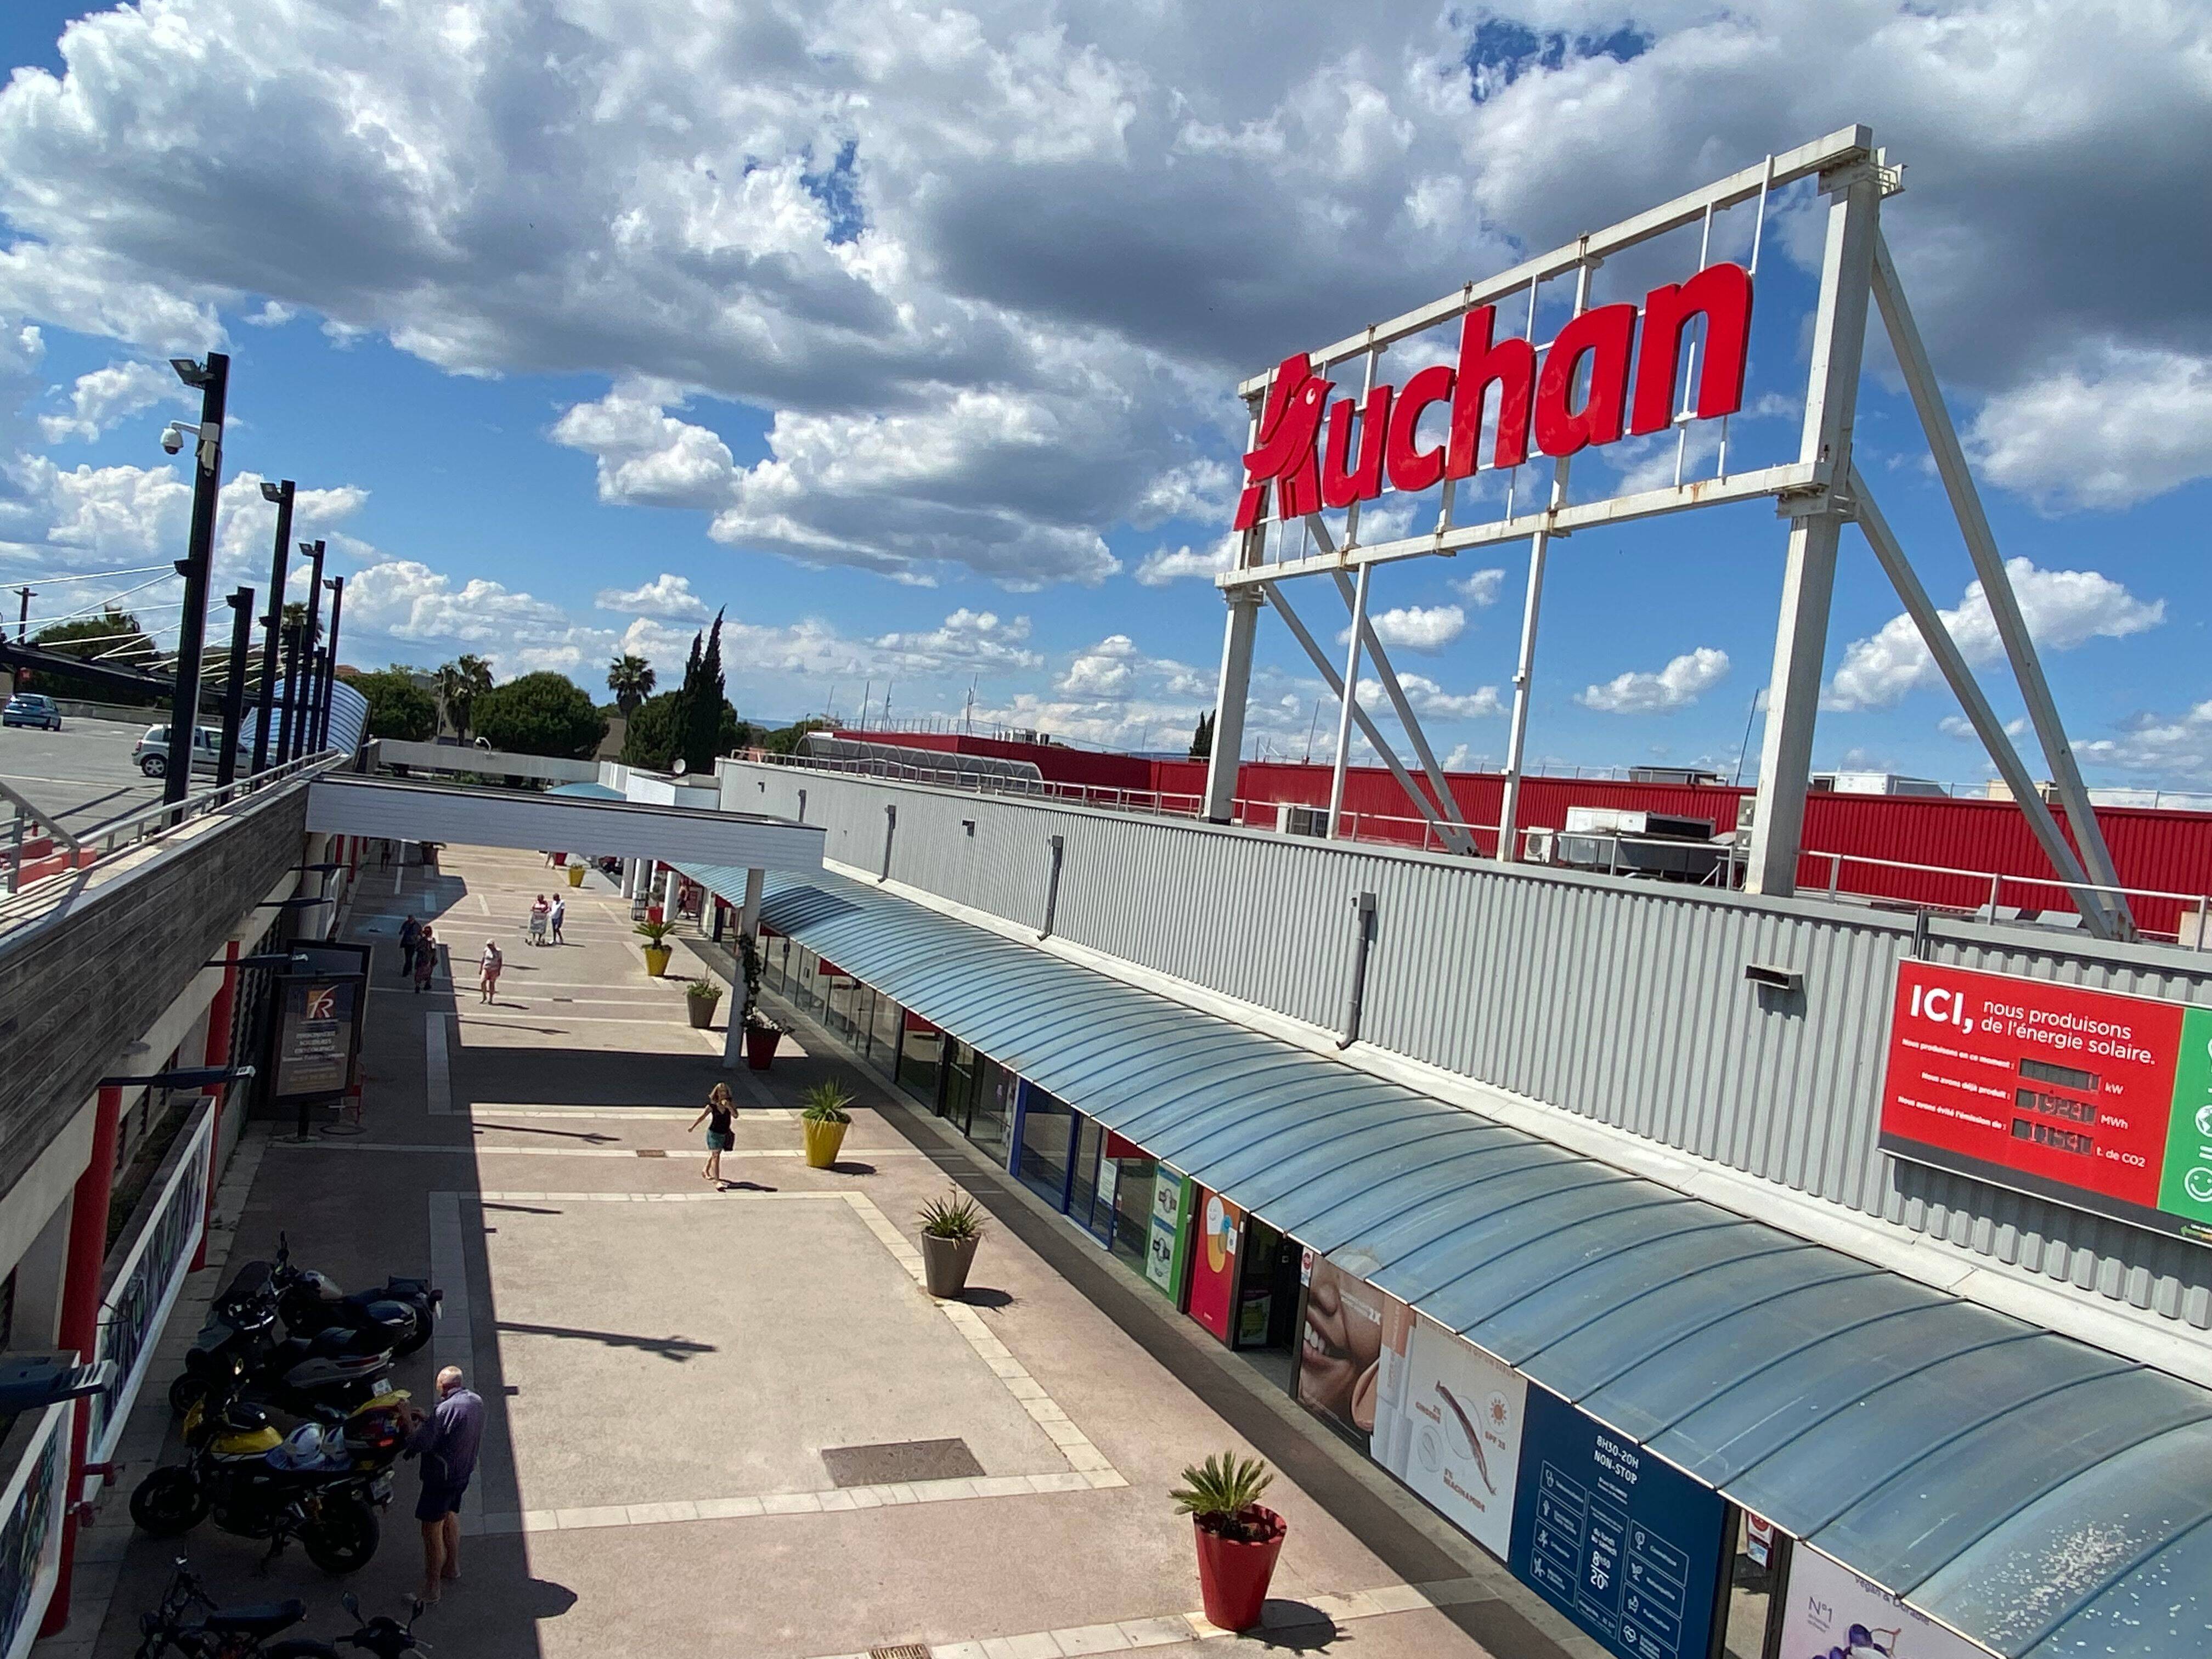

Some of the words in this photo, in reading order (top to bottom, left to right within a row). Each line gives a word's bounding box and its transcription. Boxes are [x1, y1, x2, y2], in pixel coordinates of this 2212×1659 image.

[1233, 263, 1753, 531] Auchan
[1910, 985, 1974, 1035] ICI,
[1983, 1000, 2024, 1020] nous
[2029, 1008, 2132, 1040] produisons
[1980, 1017, 2003, 1034] de
[2007, 1022, 2083, 1049] l'énergie
[2087, 1036, 2155, 1065] solaire.
[2105, 1082, 2124, 1096] kW
[2100, 1114, 2129, 1130] MWh
[2106, 1149, 2120, 1161] de
[2121, 1152, 2146, 1167] CO2
[1594, 1450, 1638, 1485] NON-STOP
[1596, 1435, 1639, 1469] 8H30-20H
